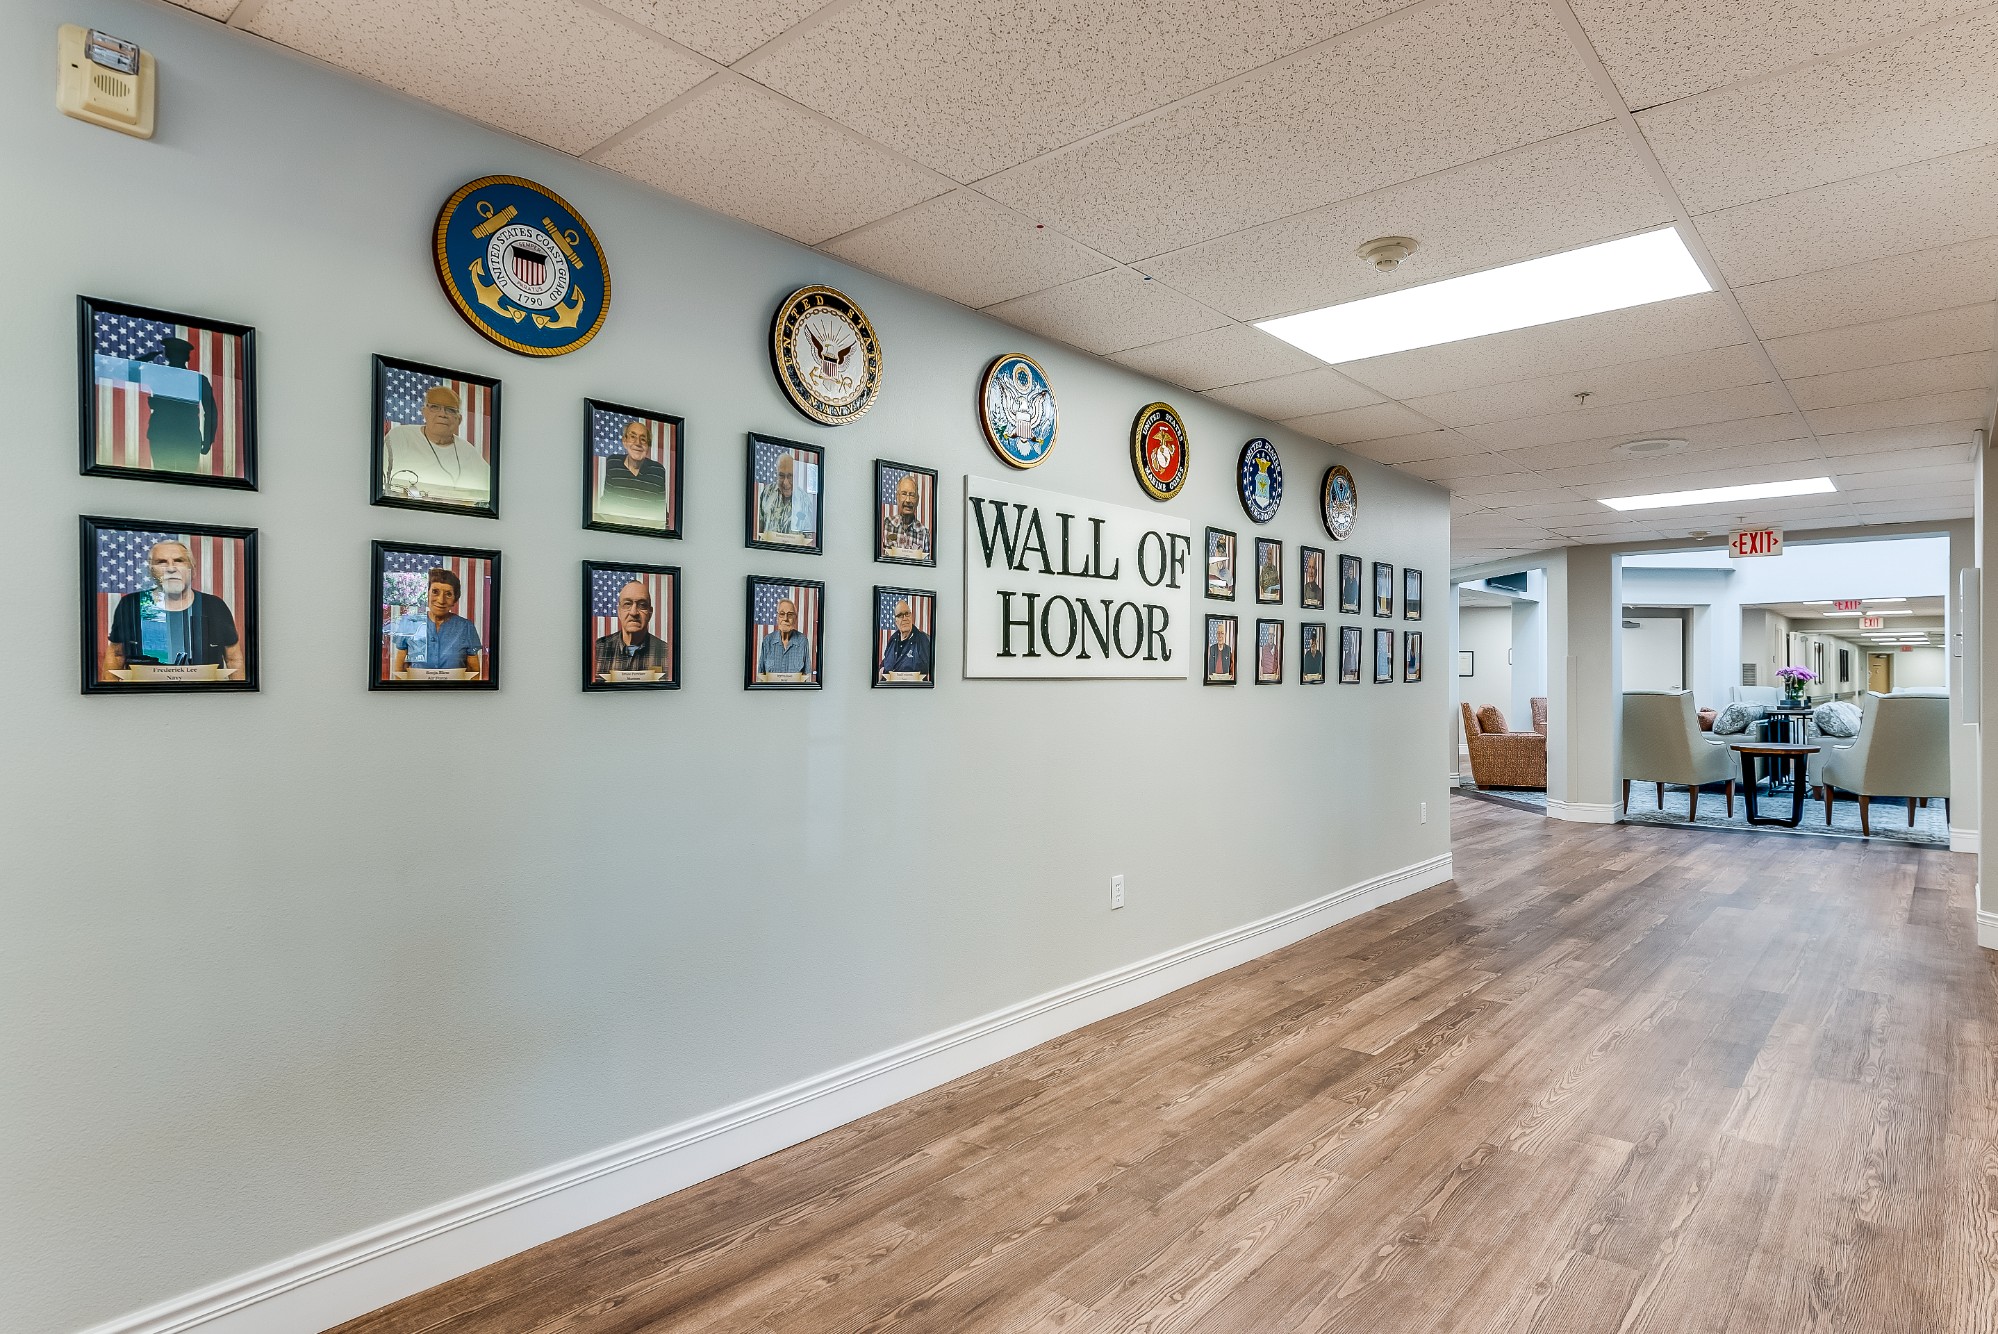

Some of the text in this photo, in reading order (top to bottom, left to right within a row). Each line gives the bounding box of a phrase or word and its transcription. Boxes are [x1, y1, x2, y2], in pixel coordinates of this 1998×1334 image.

[518, 242, 541, 252] SEMPER
[491, 228, 567, 301] UNITED STATES COAST GUARD
[517, 293, 543, 306] 1790
[783, 295, 824, 366] UNITED
[809, 396, 857, 416] NAVY
[1142, 412, 1183, 442] UNITED STATES
[1144, 466, 1184, 492] MARINE CORPS
[969, 496, 1191, 589] WALL OF
[1739, 531, 1774, 555] EXIT
[1838, 600, 1858, 610] EXIT
[996, 590, 1172, 662] HONOR
[1864, 617, 1880, 628] EXIT
